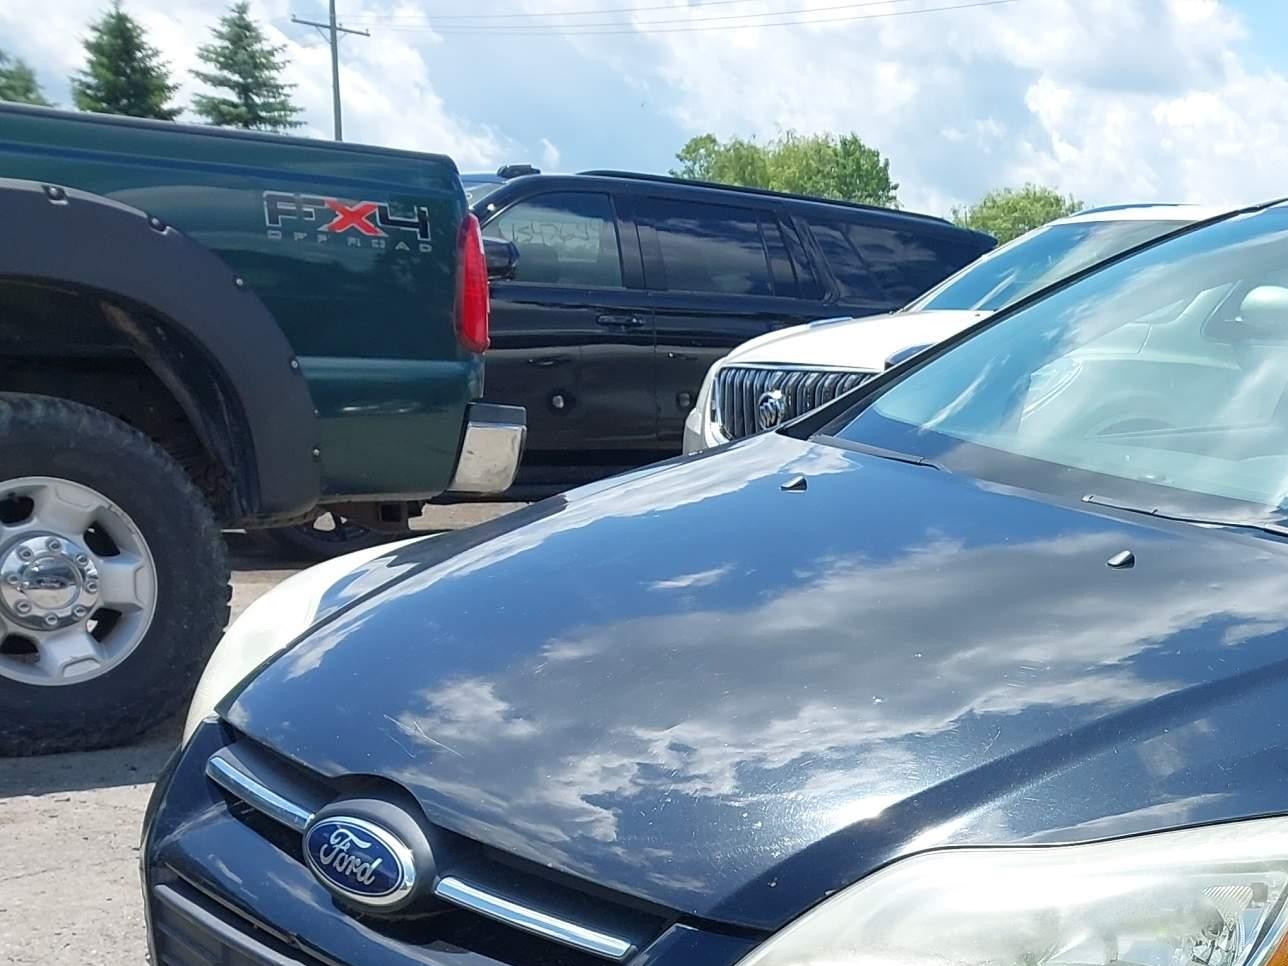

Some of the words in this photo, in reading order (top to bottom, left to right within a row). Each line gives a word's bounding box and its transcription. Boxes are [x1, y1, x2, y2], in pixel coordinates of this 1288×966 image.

[263, 190, 432, 241] FX4
[267, 230, 330, 244] OFF
[347, 236, 433, 253] ROAD
[319, 827, 384, 886] Ford
